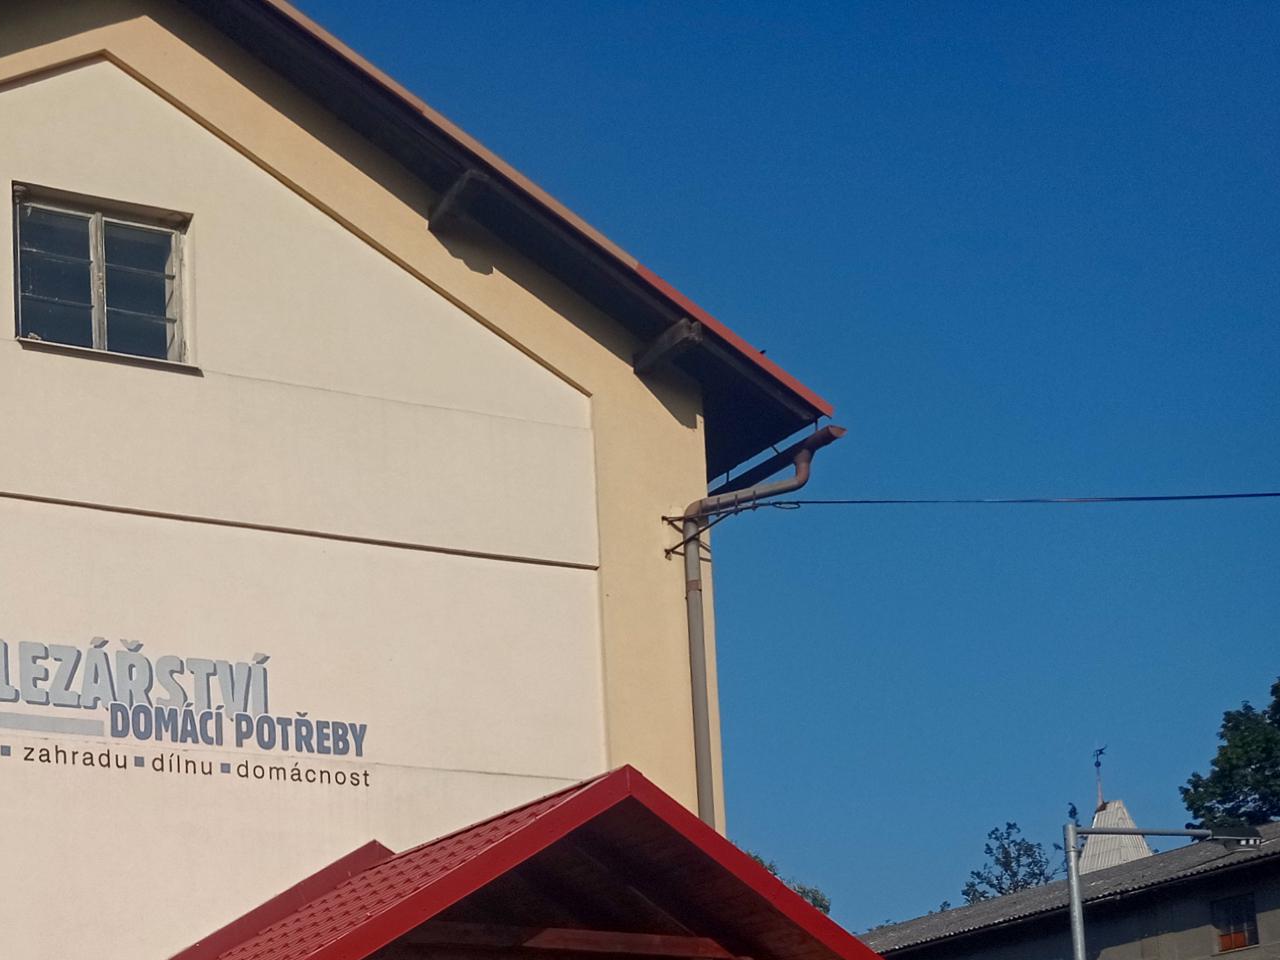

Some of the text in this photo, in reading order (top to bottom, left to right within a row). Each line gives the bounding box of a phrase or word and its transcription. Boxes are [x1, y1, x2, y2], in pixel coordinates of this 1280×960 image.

[109, 701, 368, 757] DOMÁCÍ POTŘEBY
[23, 743, 128, 770] zahradu
[151, 752, 214, 776] dílnu
[236, 760, 370, 787] domácnost
